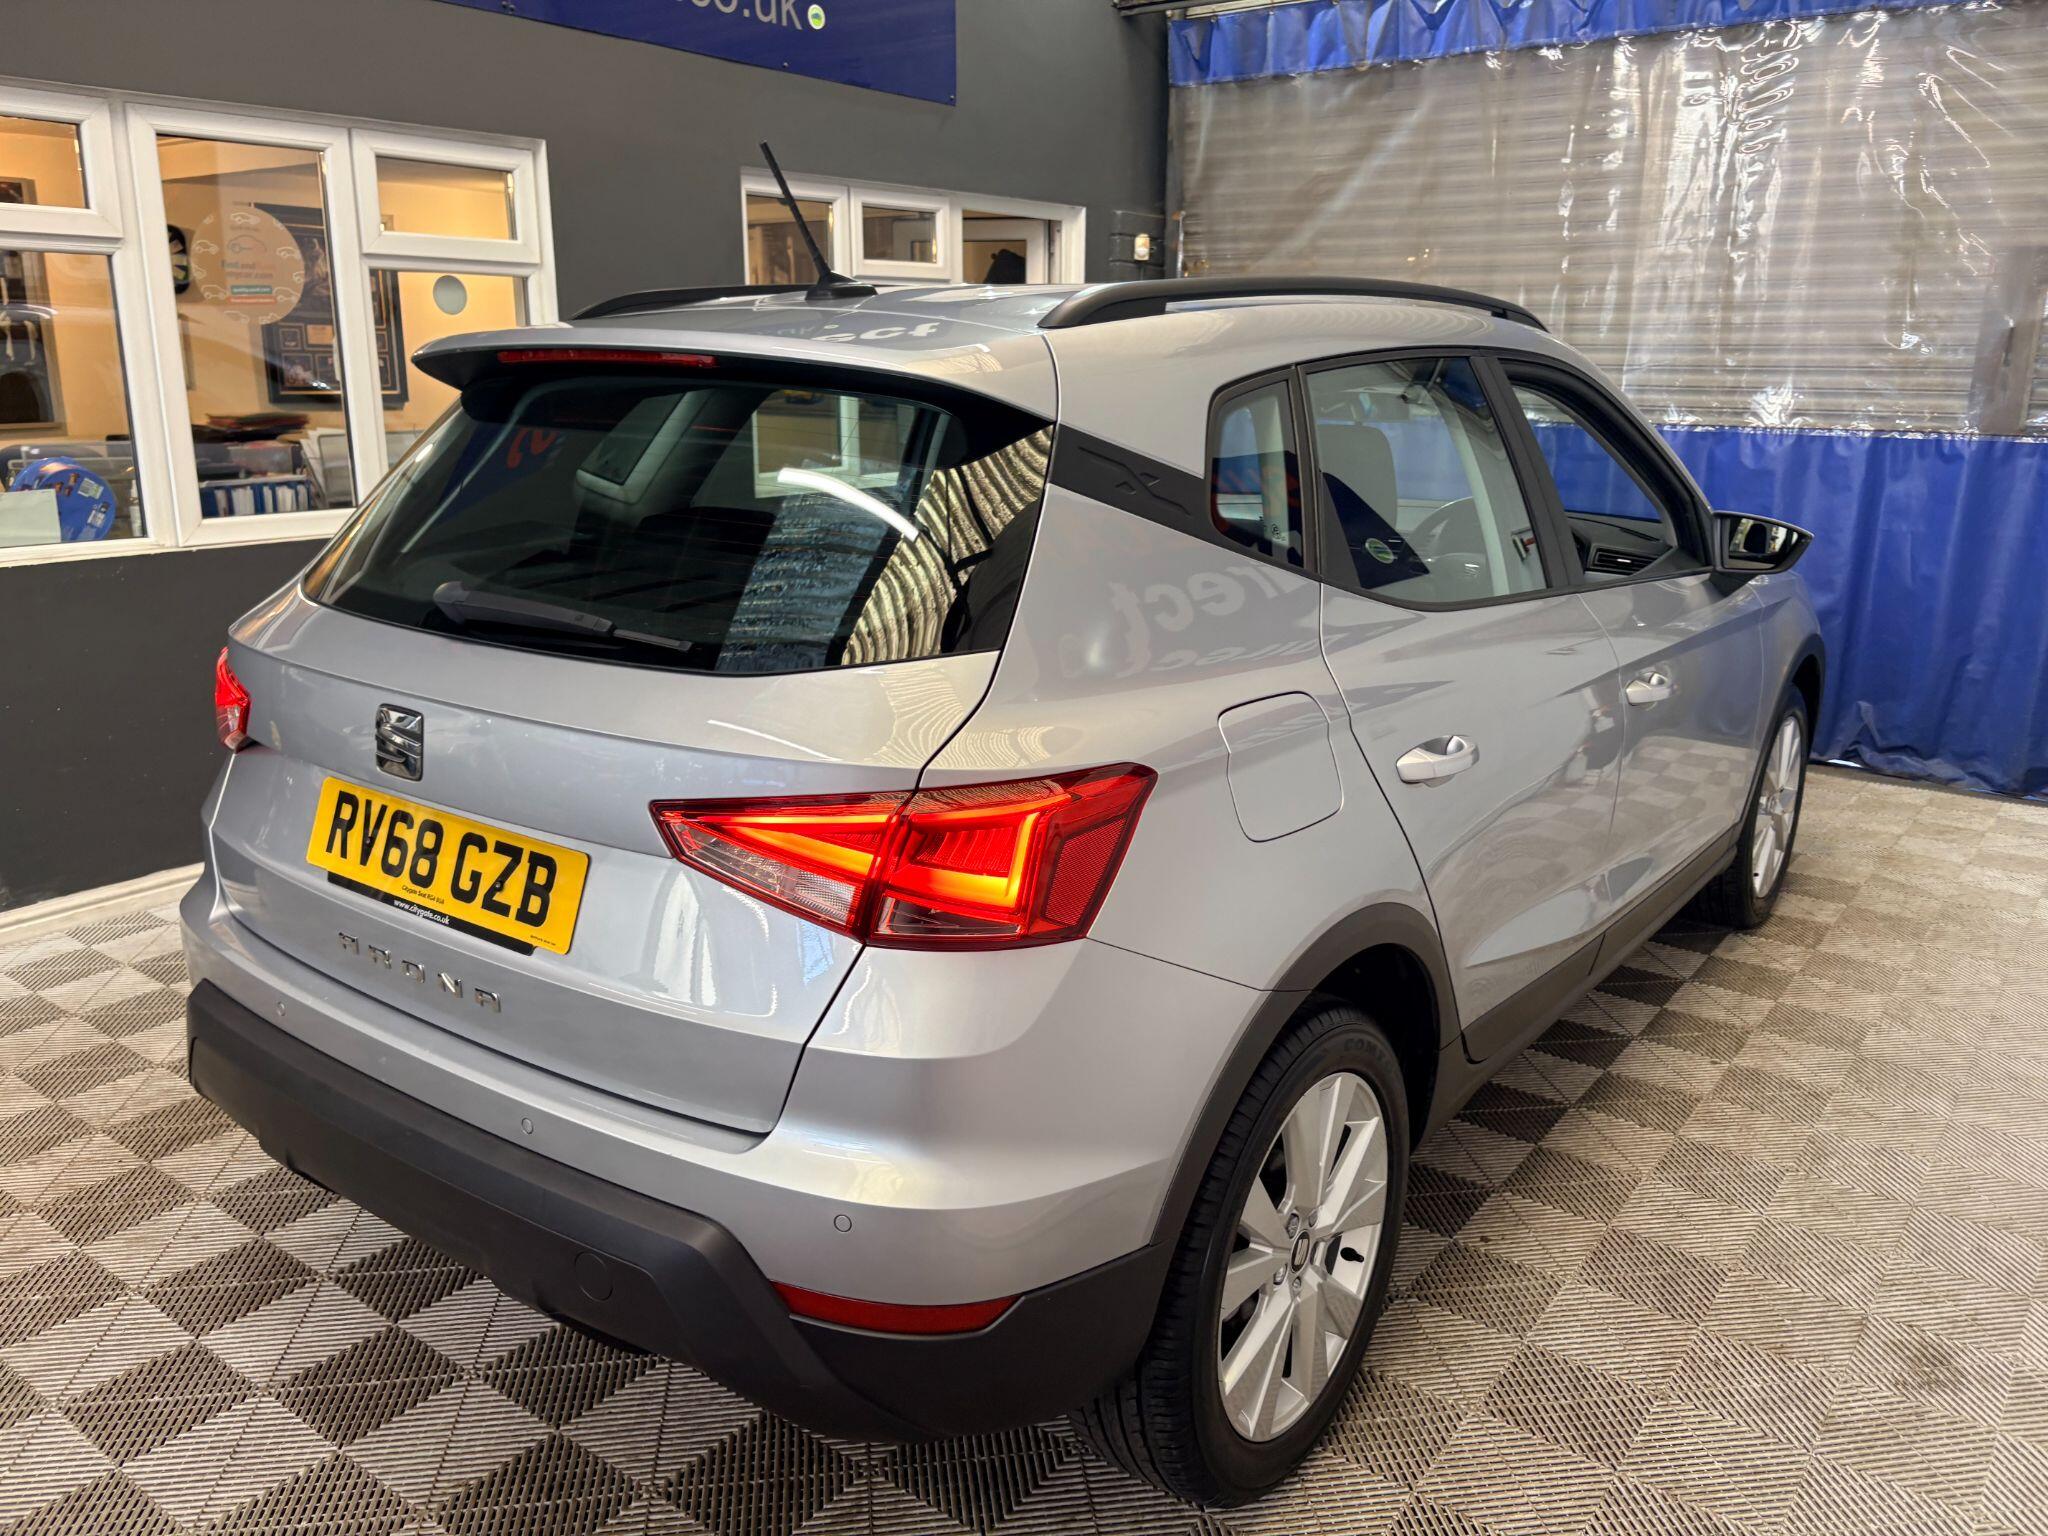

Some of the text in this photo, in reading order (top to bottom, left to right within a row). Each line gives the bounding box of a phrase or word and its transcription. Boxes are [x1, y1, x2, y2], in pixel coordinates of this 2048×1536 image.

[325, 790, 558, 928] RV68 GZB
[393, 899, 450, 925] www.citygate.co.uk
[338, 932, 502, 1014] ARONA
